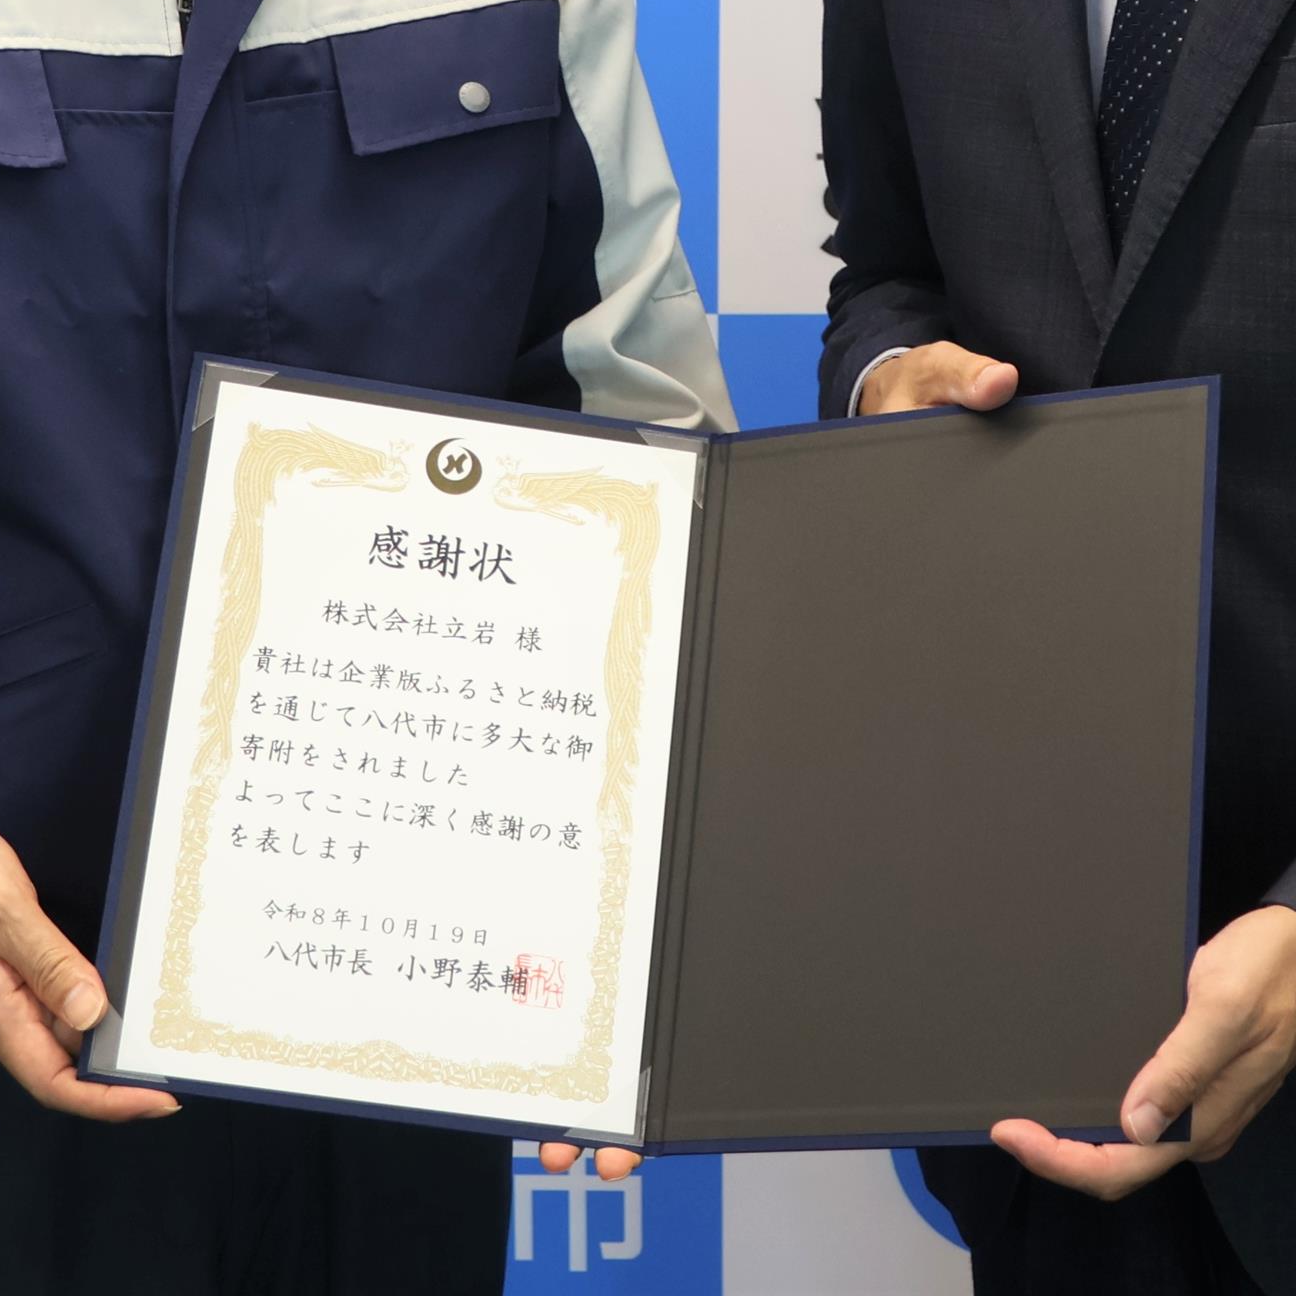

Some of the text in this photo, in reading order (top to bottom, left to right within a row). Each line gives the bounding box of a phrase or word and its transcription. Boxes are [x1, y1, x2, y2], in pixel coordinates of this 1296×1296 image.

[369, 525, 516, 584] 感謝状
[323, 600, 542, 652] 株式会社立岩 様
[252, 645, 598, 718] 貴社は企業版ふるさと納税
[249, 690, 594, 762] を通じて八代市に多大な御
[238, 733, 469, 787] 寄附をされました
[234, 778, 583, 851] よってここに深く感謝の意
[229, 822, 372, 865] を表します
[262, 940, 375, 978] 八代市長
